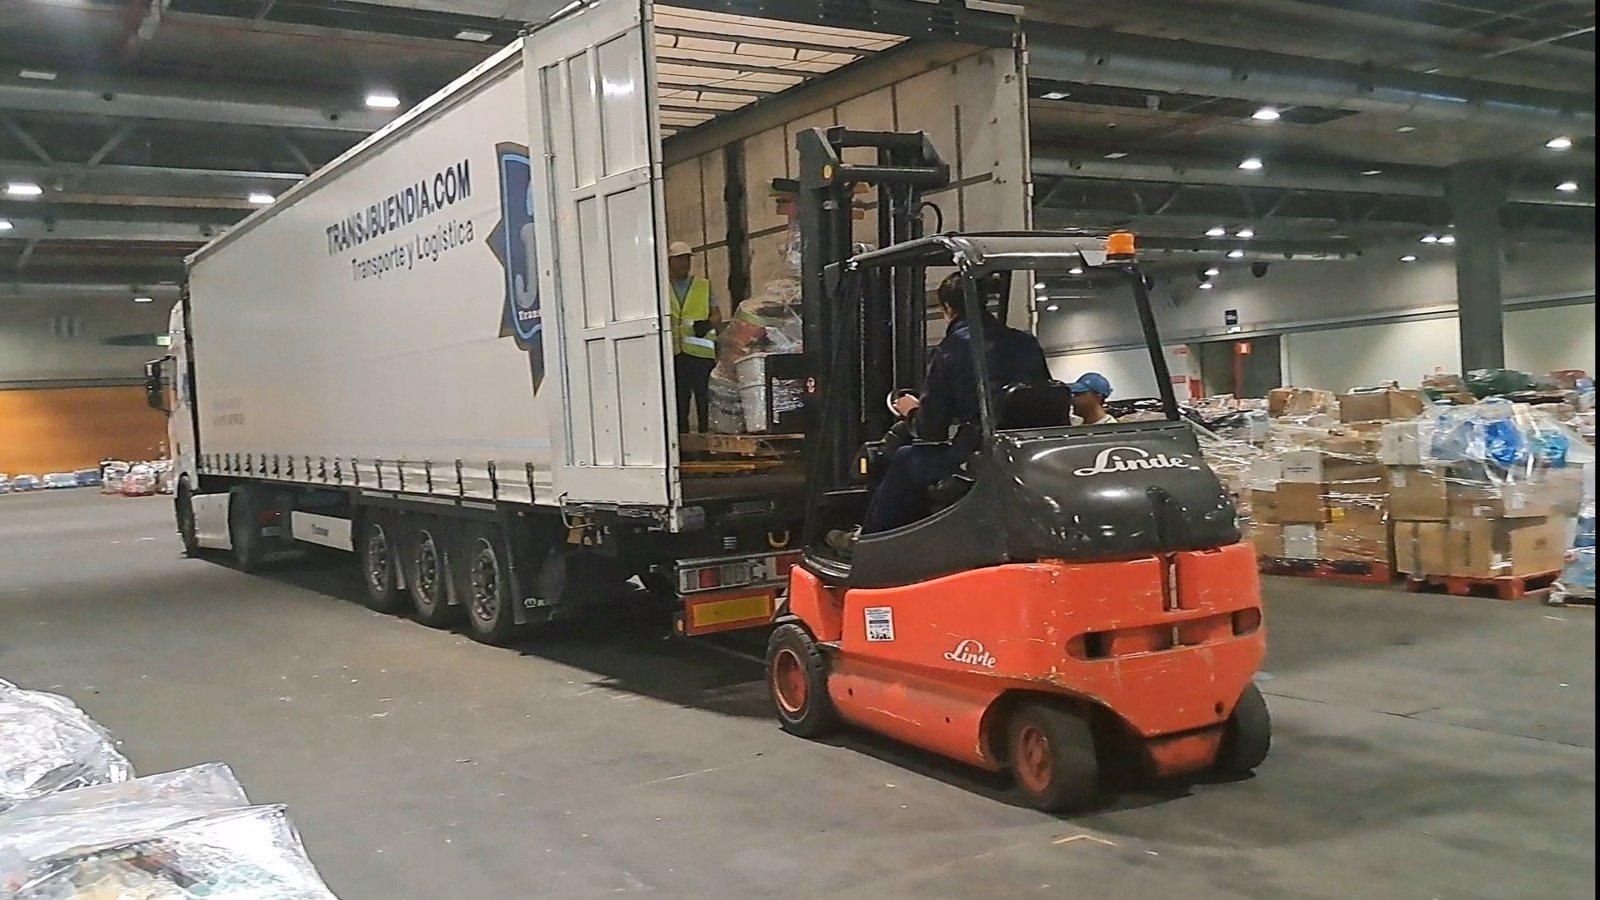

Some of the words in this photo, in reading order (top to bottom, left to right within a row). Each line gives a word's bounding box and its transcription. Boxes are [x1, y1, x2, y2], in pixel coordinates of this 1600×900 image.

[326, 159, 471, 255] TRANSJBUENDIA.COM
[354, 246, 405, 281] Transporte
[405, 246, 414, 270] y
[1073, 446, 1189, 476] Linde
[943, 639, 996, 670] Linde
